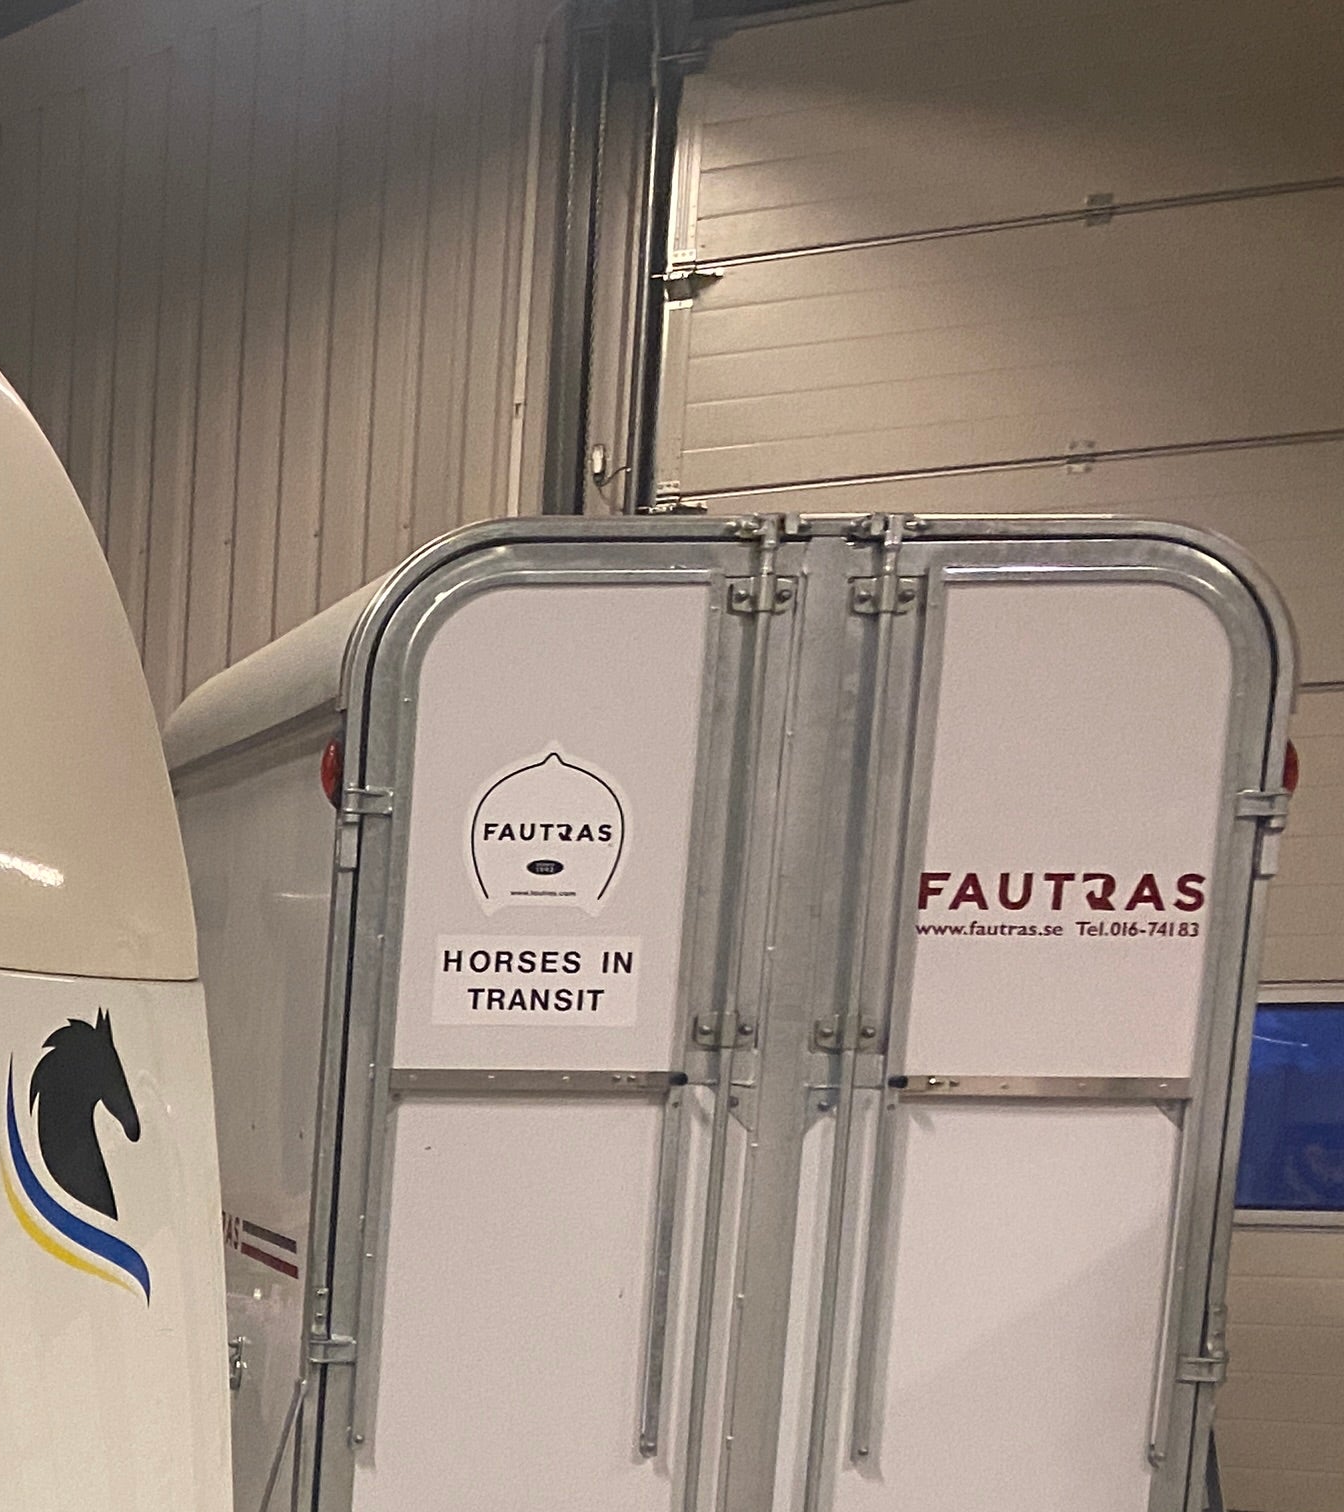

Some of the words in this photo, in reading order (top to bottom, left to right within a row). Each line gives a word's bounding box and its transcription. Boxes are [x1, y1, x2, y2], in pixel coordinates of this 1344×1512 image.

[482, 822, 613, 842] FAUTRAS
[917, 872, 1207, 912] FAUTRAS
[915, 921, 1063, 936] www.fautras.se
[443, 950, 581, 974] HORSES
[601, 951, 634, 974] IN
[468, 988, 605, 1011] TRANSIT
